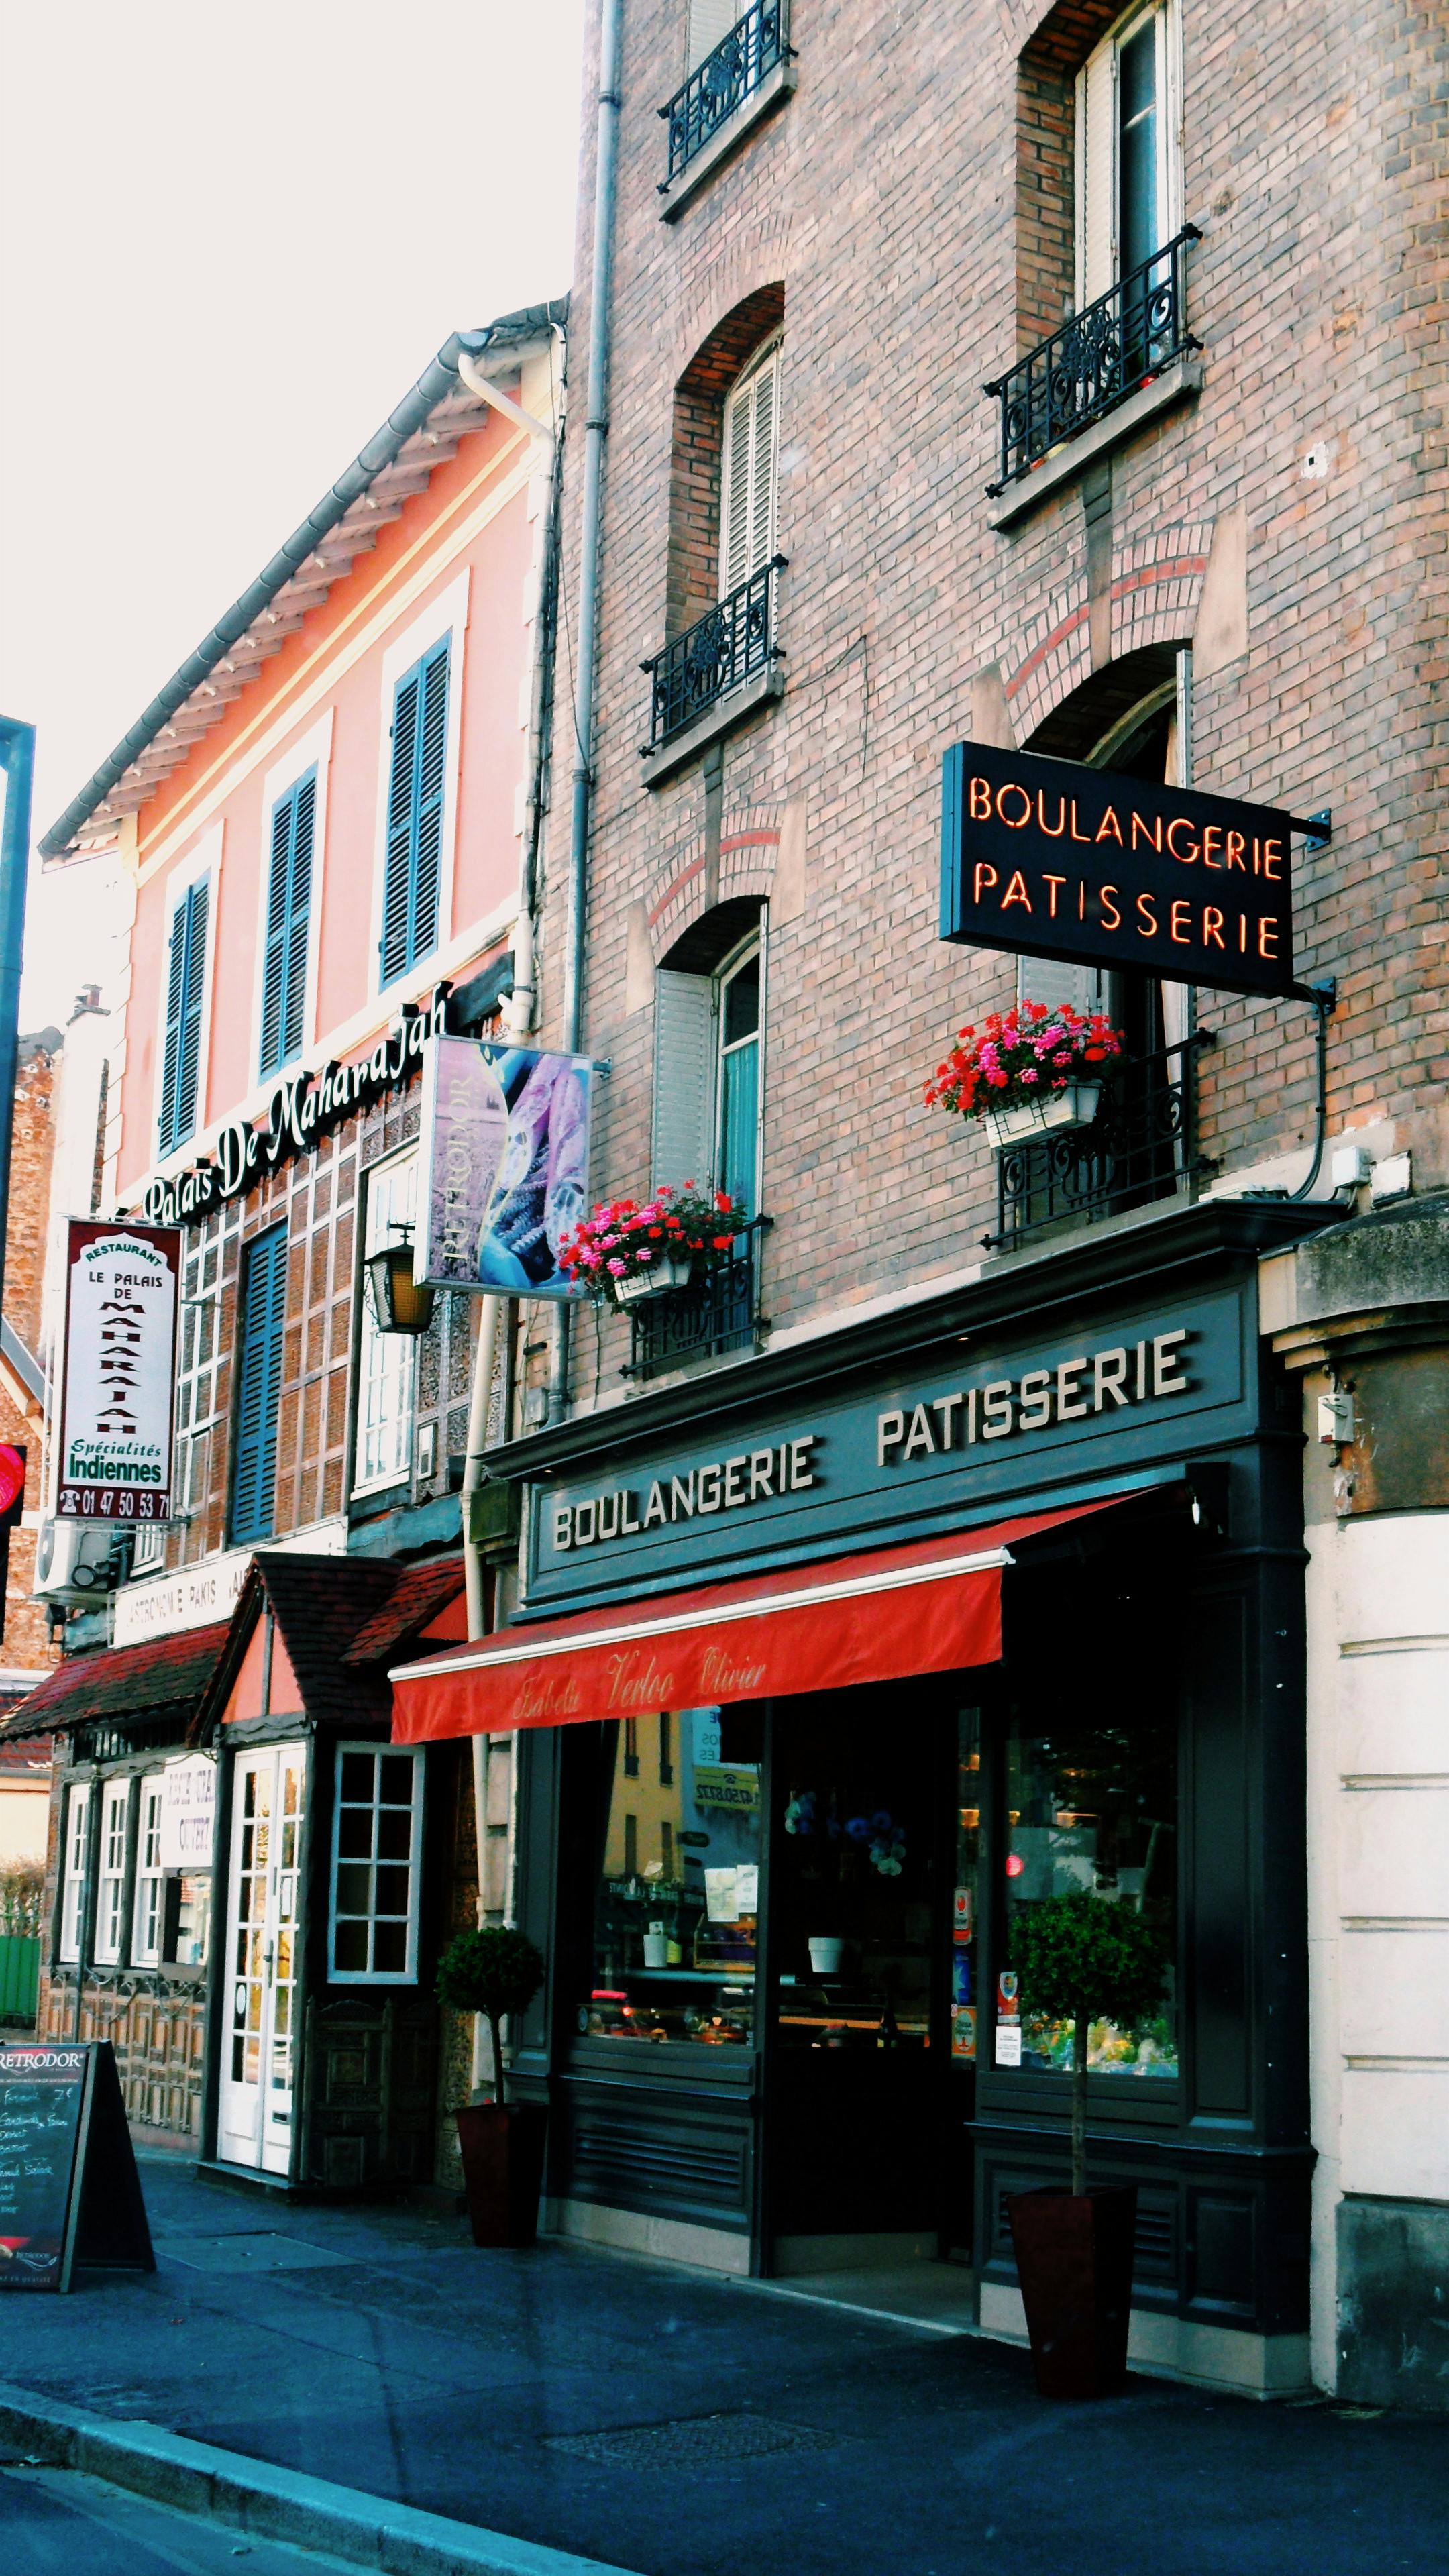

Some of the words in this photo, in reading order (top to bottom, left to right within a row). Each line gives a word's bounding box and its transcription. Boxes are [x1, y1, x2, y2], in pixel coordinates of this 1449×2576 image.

[969, 777, 1282, 881] BOULANGERIE
[973, 863, 1279, 959] PATISSERIE
[143, 1159, 213, 1225] Palais
[217, 1124, 260, 1197] De
[268, 983, 449, 1161] Maharajah
[443, 1075, 472, 1259] RETRODOR
[85, 1243, 162, 1267] RESTAURANT
[89, 1271, 104, 1283] LE
[114, 1273, 162, 1288] PALAIS
[114, 1287, 131, 1299] DE
[95, 1301, 146, 1434] MAHARAJAH
[70, 1438, 161, 1458] Spécialités
[553, 1436, 815, 1551] BOULANGERIE
[877, 1328, 1191, 1466] PATISSERIE
[70, 1453, 161, 1483] Indiennes
[82, 1489, 95, 1515] 01
[100, 1491, 114, 1515] 47
[119, 1492, 133, 1517] 50
[139, 1493, 154, 1518] 53
[159, 1494, 170, 1519] 71
[700, 1646, 767, 1694] Olivier
